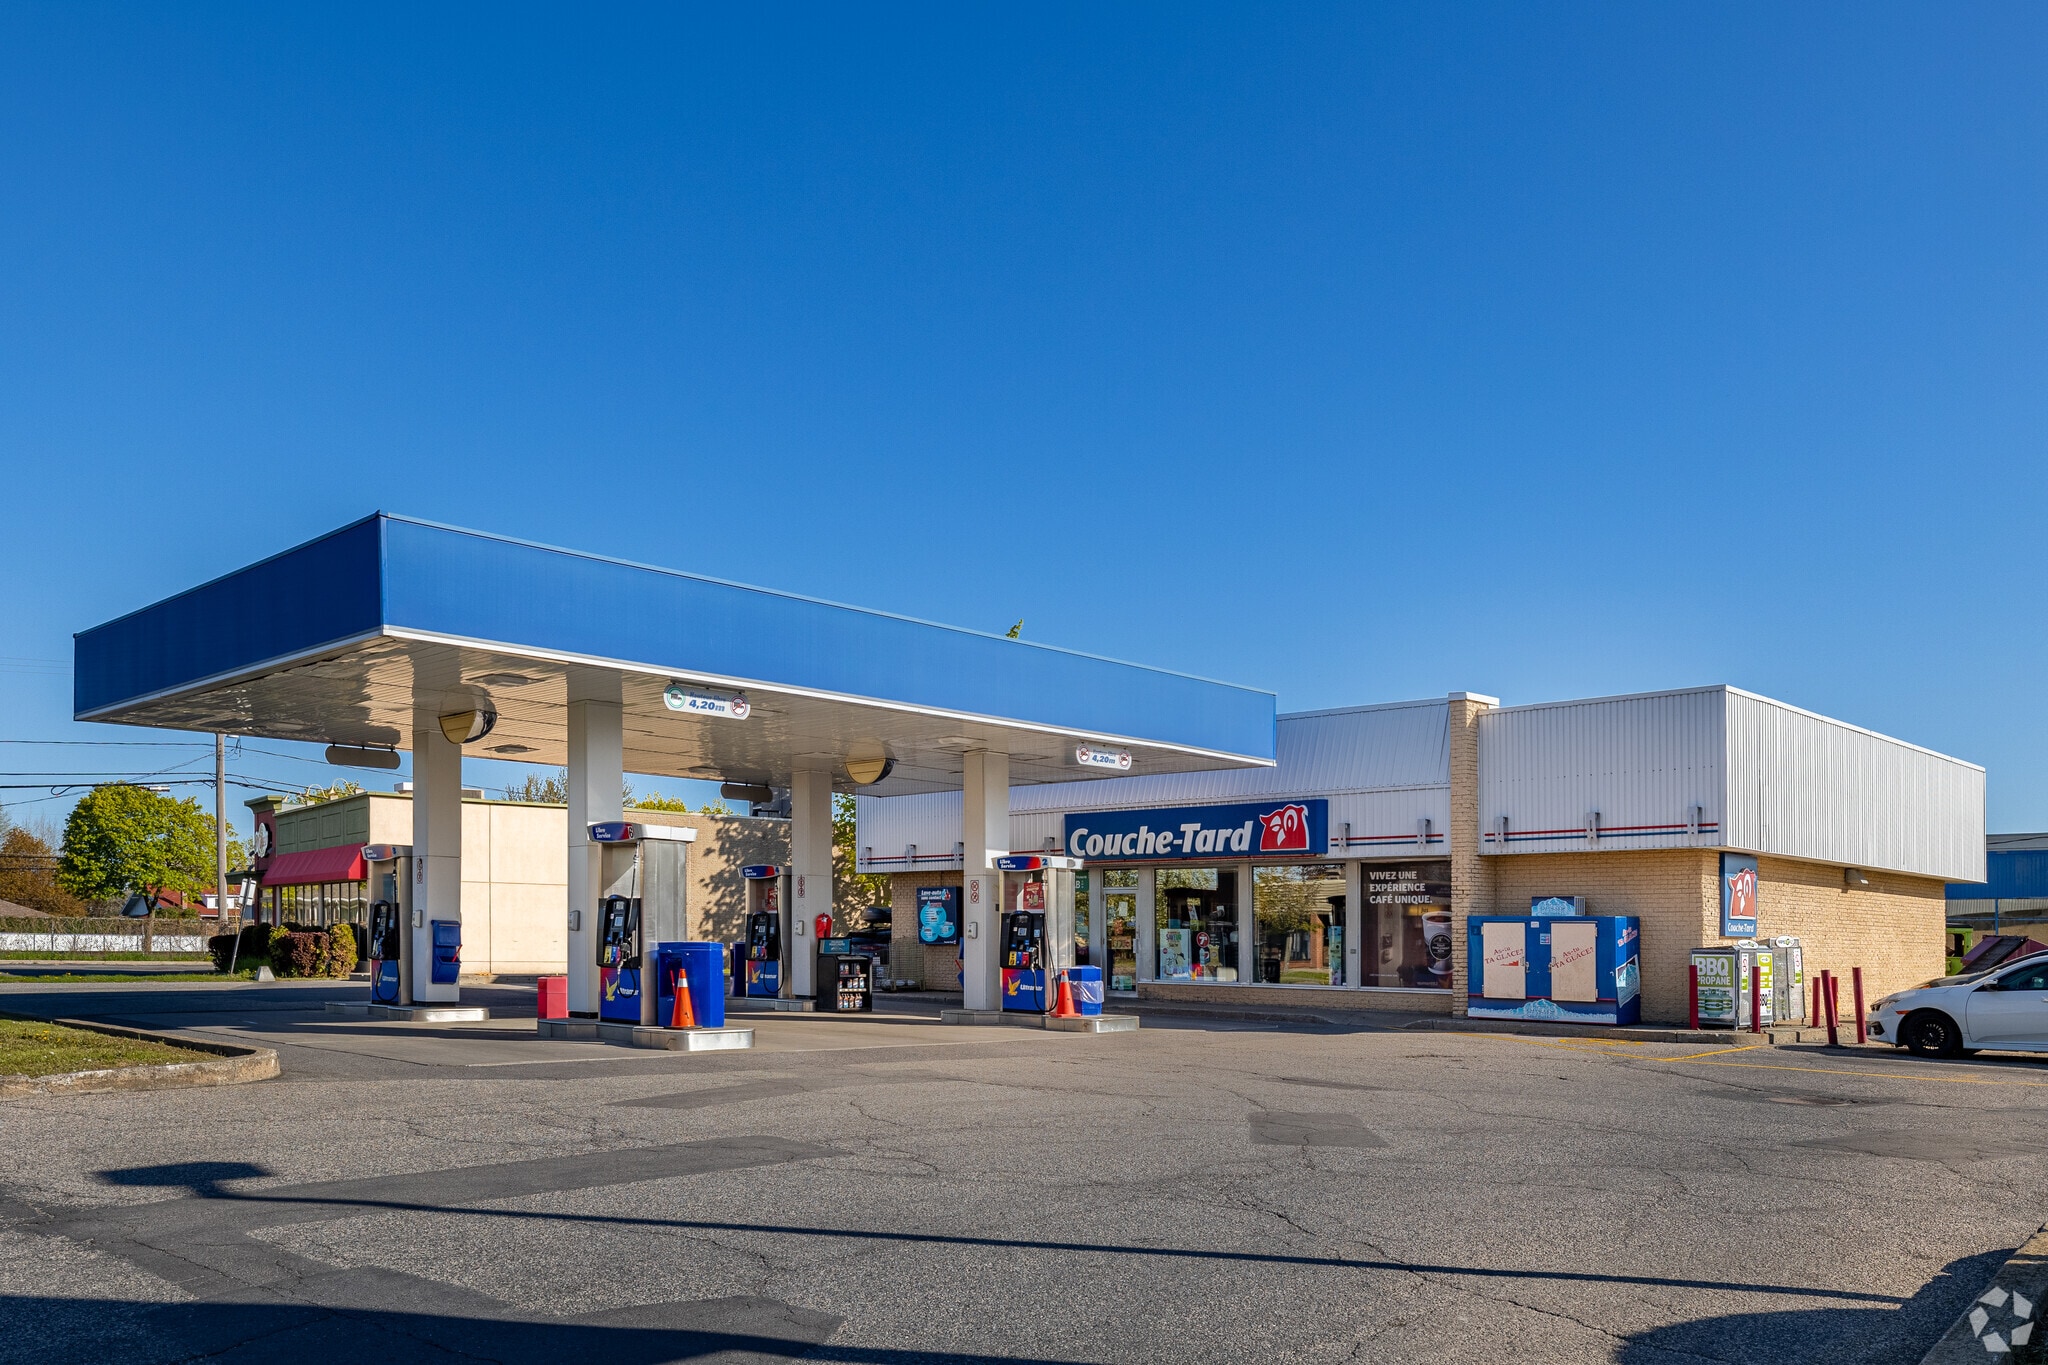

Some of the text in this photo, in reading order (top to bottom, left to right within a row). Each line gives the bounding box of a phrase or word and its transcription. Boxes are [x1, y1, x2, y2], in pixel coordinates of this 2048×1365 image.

[1069, 820, 1254, 857] Couche-Tard
[1041, 858, 1048, 866] 2
[1369, 871, 1417, 880] VIVEZ UNE
[1369, 882, 1426, 892] EXPÉRIENCE
[1369, 894, 1433, 905] CAFÉ UNIQUE.
[1728, 922, 1755, 933] Couche-Tard
[1485, 957, 1495, 965] TA
[1554, 946, 1594, 968] TA GLACE?
[1695, 957, 1728, 976] BBQ
[1697, 976, 1731, 985] PROPANE
